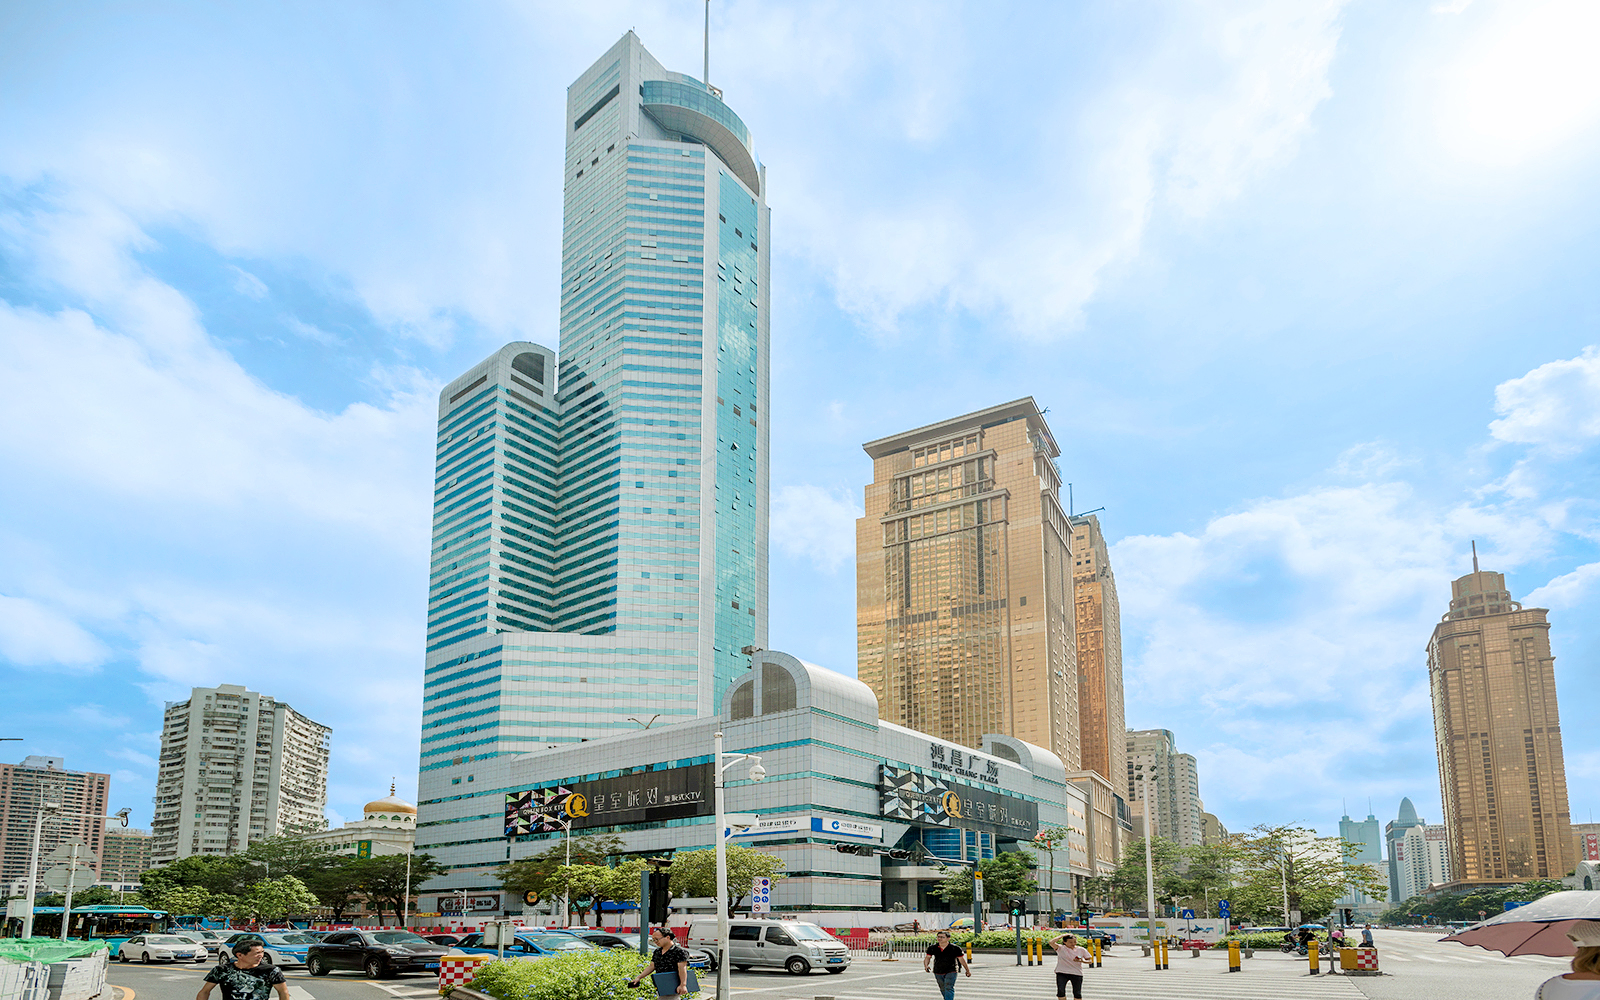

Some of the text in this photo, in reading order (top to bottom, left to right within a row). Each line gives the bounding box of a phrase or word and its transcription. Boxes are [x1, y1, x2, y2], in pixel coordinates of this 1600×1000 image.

[930, 743, 999, 777] 鸿昌广场
[932, 761, 999, 784] HONG CHANG PLAZA
[593, 787, 658, 811] 皇室派对
[963, 798, 1008, 823] 皇室派对
